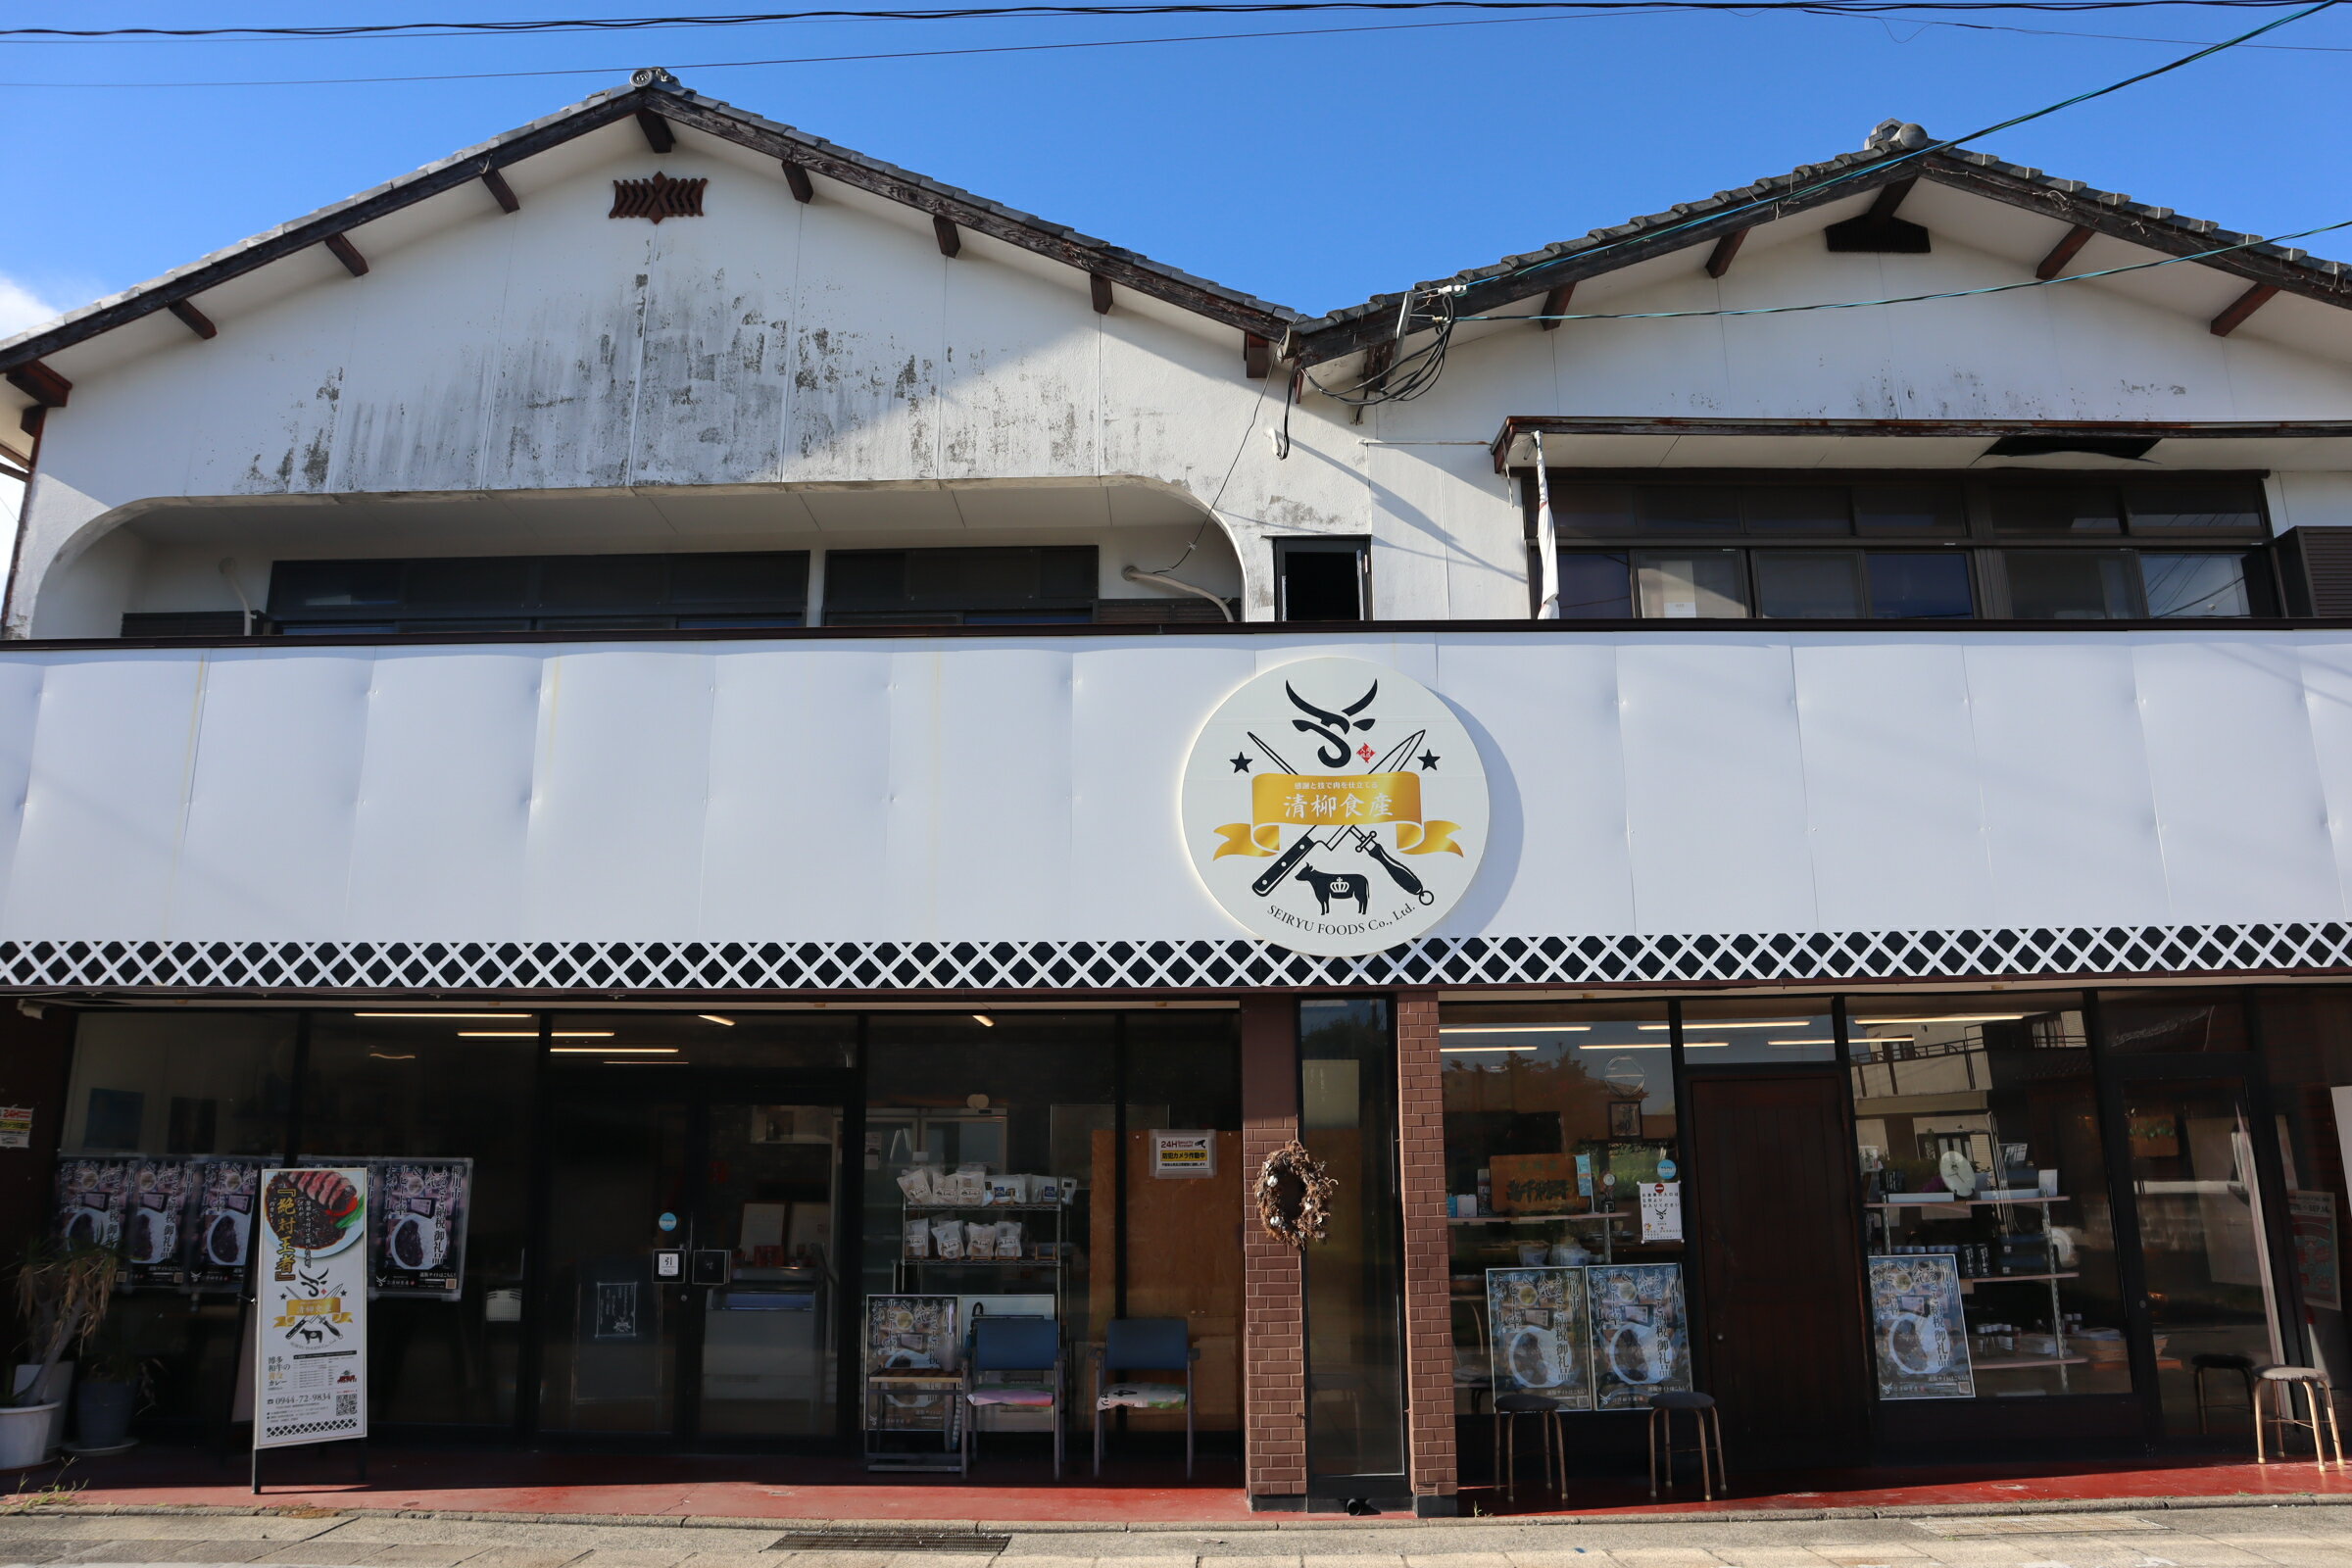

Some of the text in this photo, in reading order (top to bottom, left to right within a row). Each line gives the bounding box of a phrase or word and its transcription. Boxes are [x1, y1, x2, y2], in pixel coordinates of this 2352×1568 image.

[1294, 781, 1379, 790] 感謝と技で肉を仕立てる
[1285, 793, 1394, 818] 清柳食産
[1267, 903, 1416, 936] SEIRYU FOODS Co., Ltd.
[452, 1164, 464, 1199] 柳川市
[274, 1189, 296, 1281] 『絶対王者』
[432, 1230, 445, 1265] 御礼品
[1568, 1271, 1581, 1308] 柳川市
[1667, 1268, 1679, 1304] 柳川市
[1556, 1344, 1570, 1381] 御礼品
[1656, 1340, 1671, 1377] 御礼品
[275, 1393, 331, 1404] 0944-72-9834
